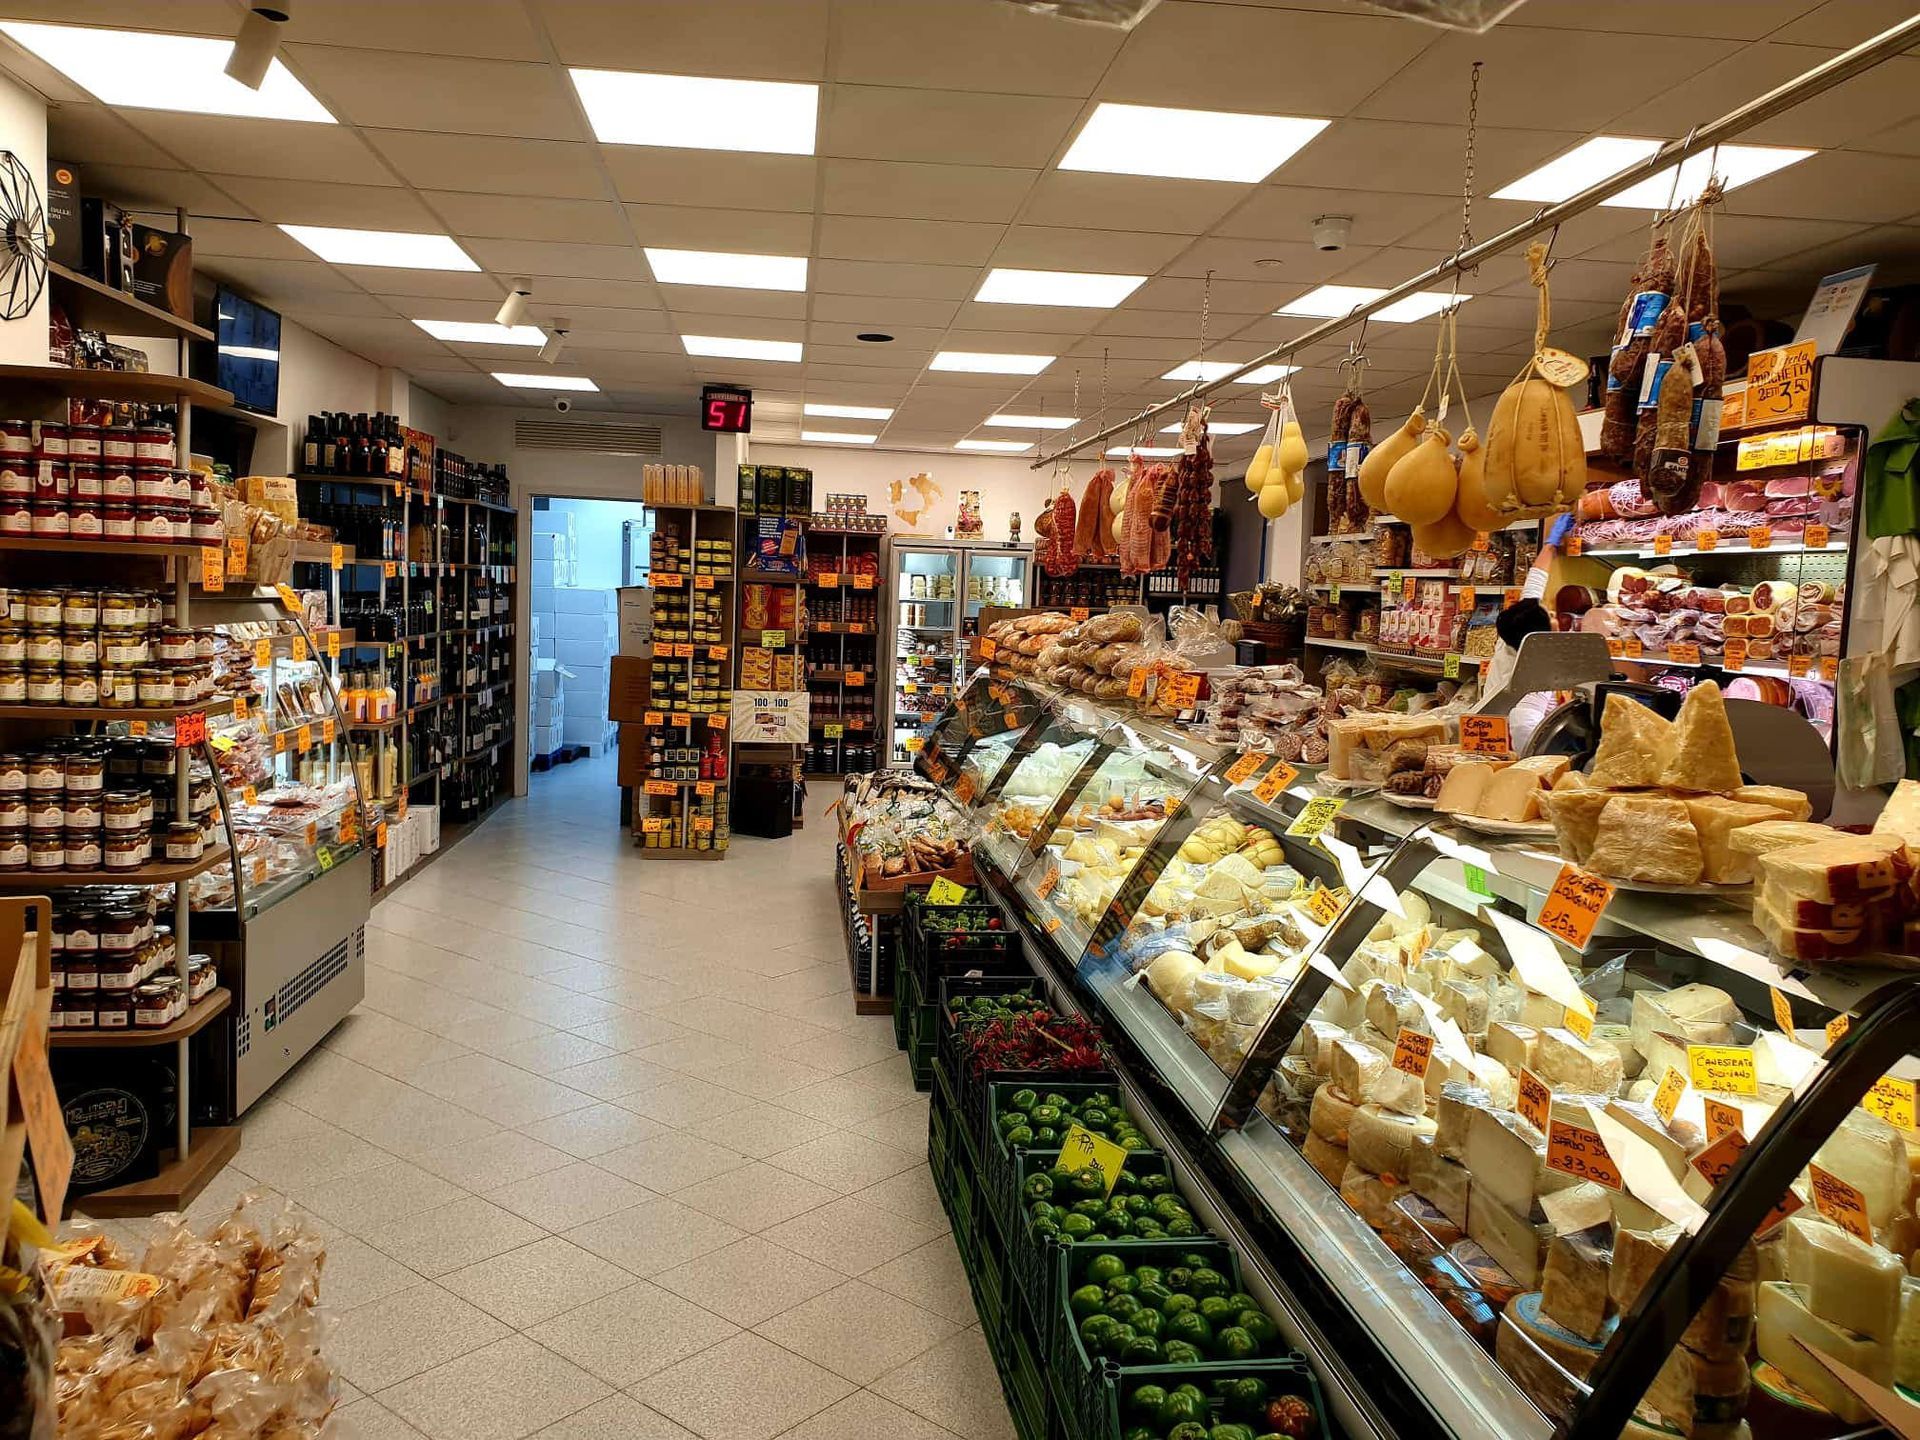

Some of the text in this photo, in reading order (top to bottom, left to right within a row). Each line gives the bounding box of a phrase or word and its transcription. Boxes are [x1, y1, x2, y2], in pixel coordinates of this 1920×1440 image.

[708, 401, 747, 428] 51
[754, 698, 789, 708] 100 100
[1696, 1054, 1753, 1067] CANESTRATO
